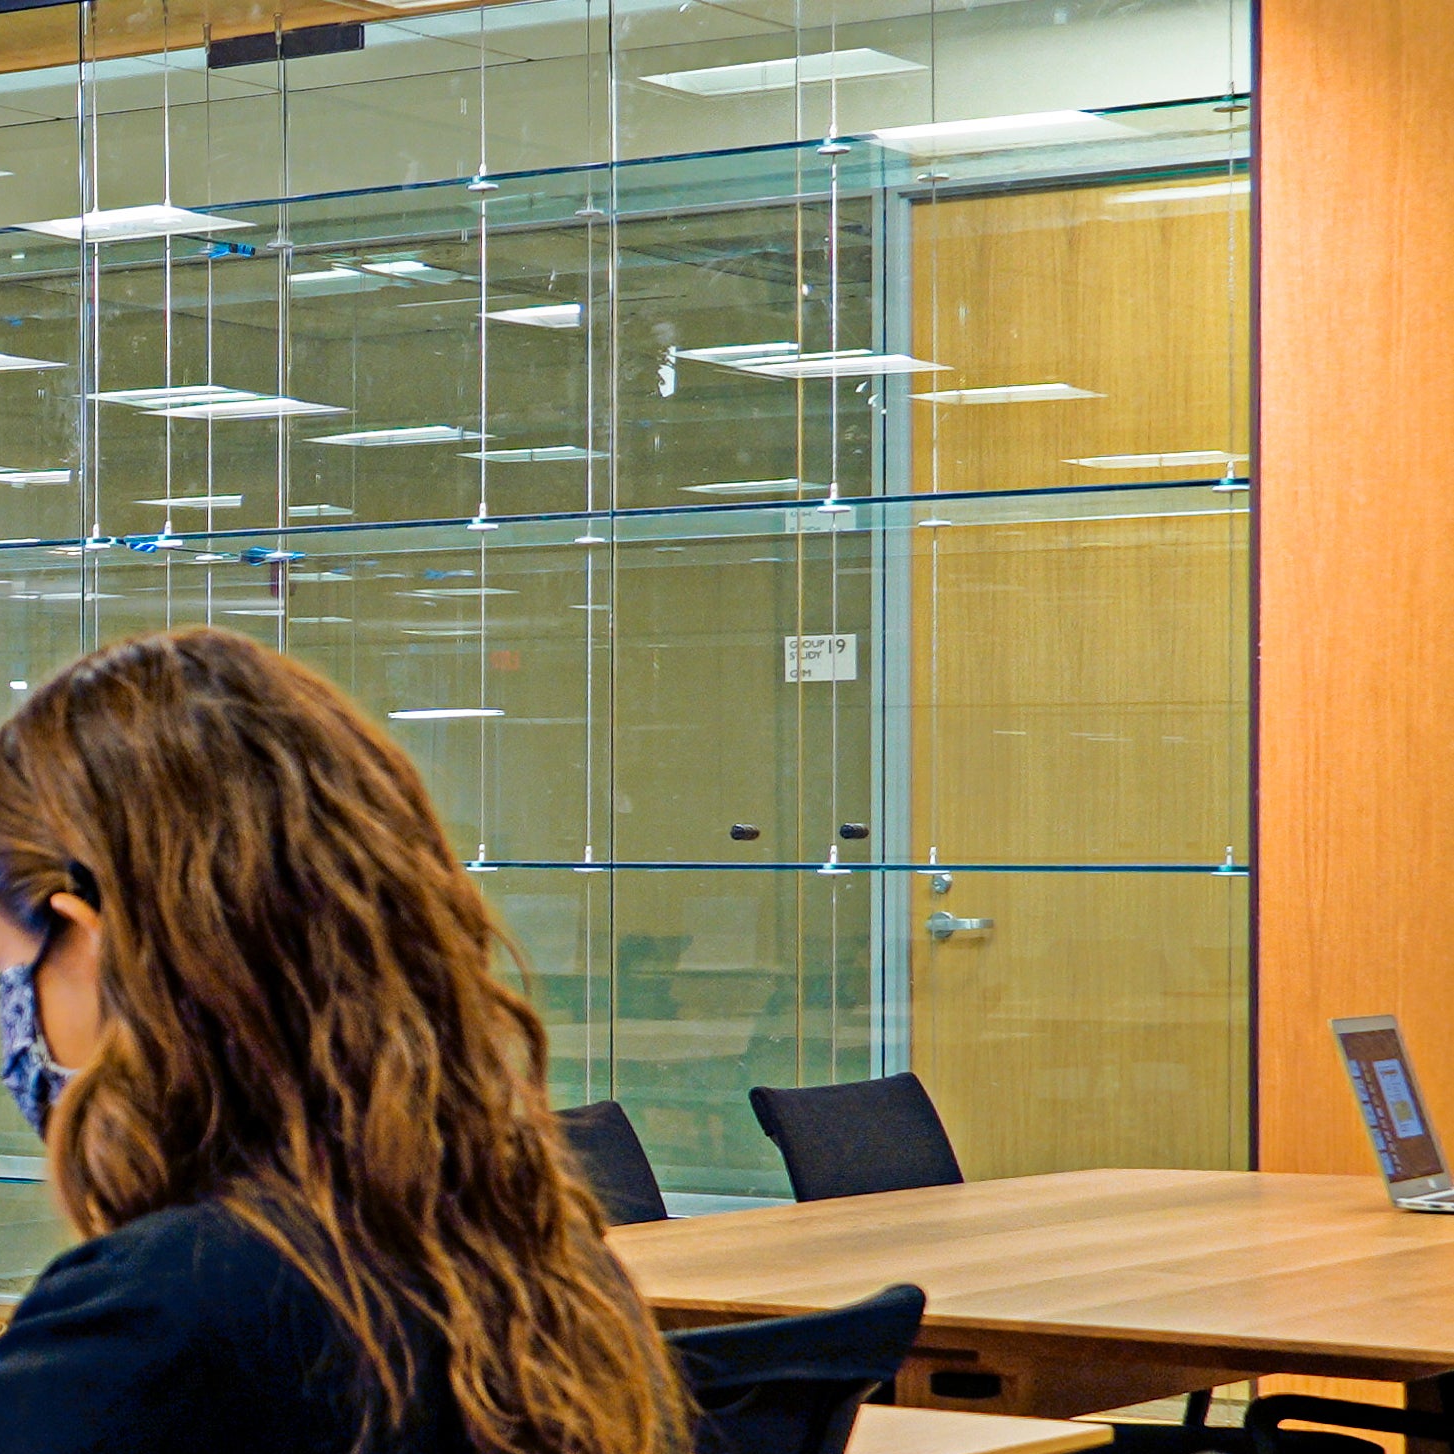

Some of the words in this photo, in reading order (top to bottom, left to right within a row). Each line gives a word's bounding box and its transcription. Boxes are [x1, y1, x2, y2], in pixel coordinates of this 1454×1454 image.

[789, 639, 825, 649] GOUP
[829, 638, 846, 654] 19
[789, 651, 821, 660] SUDY
